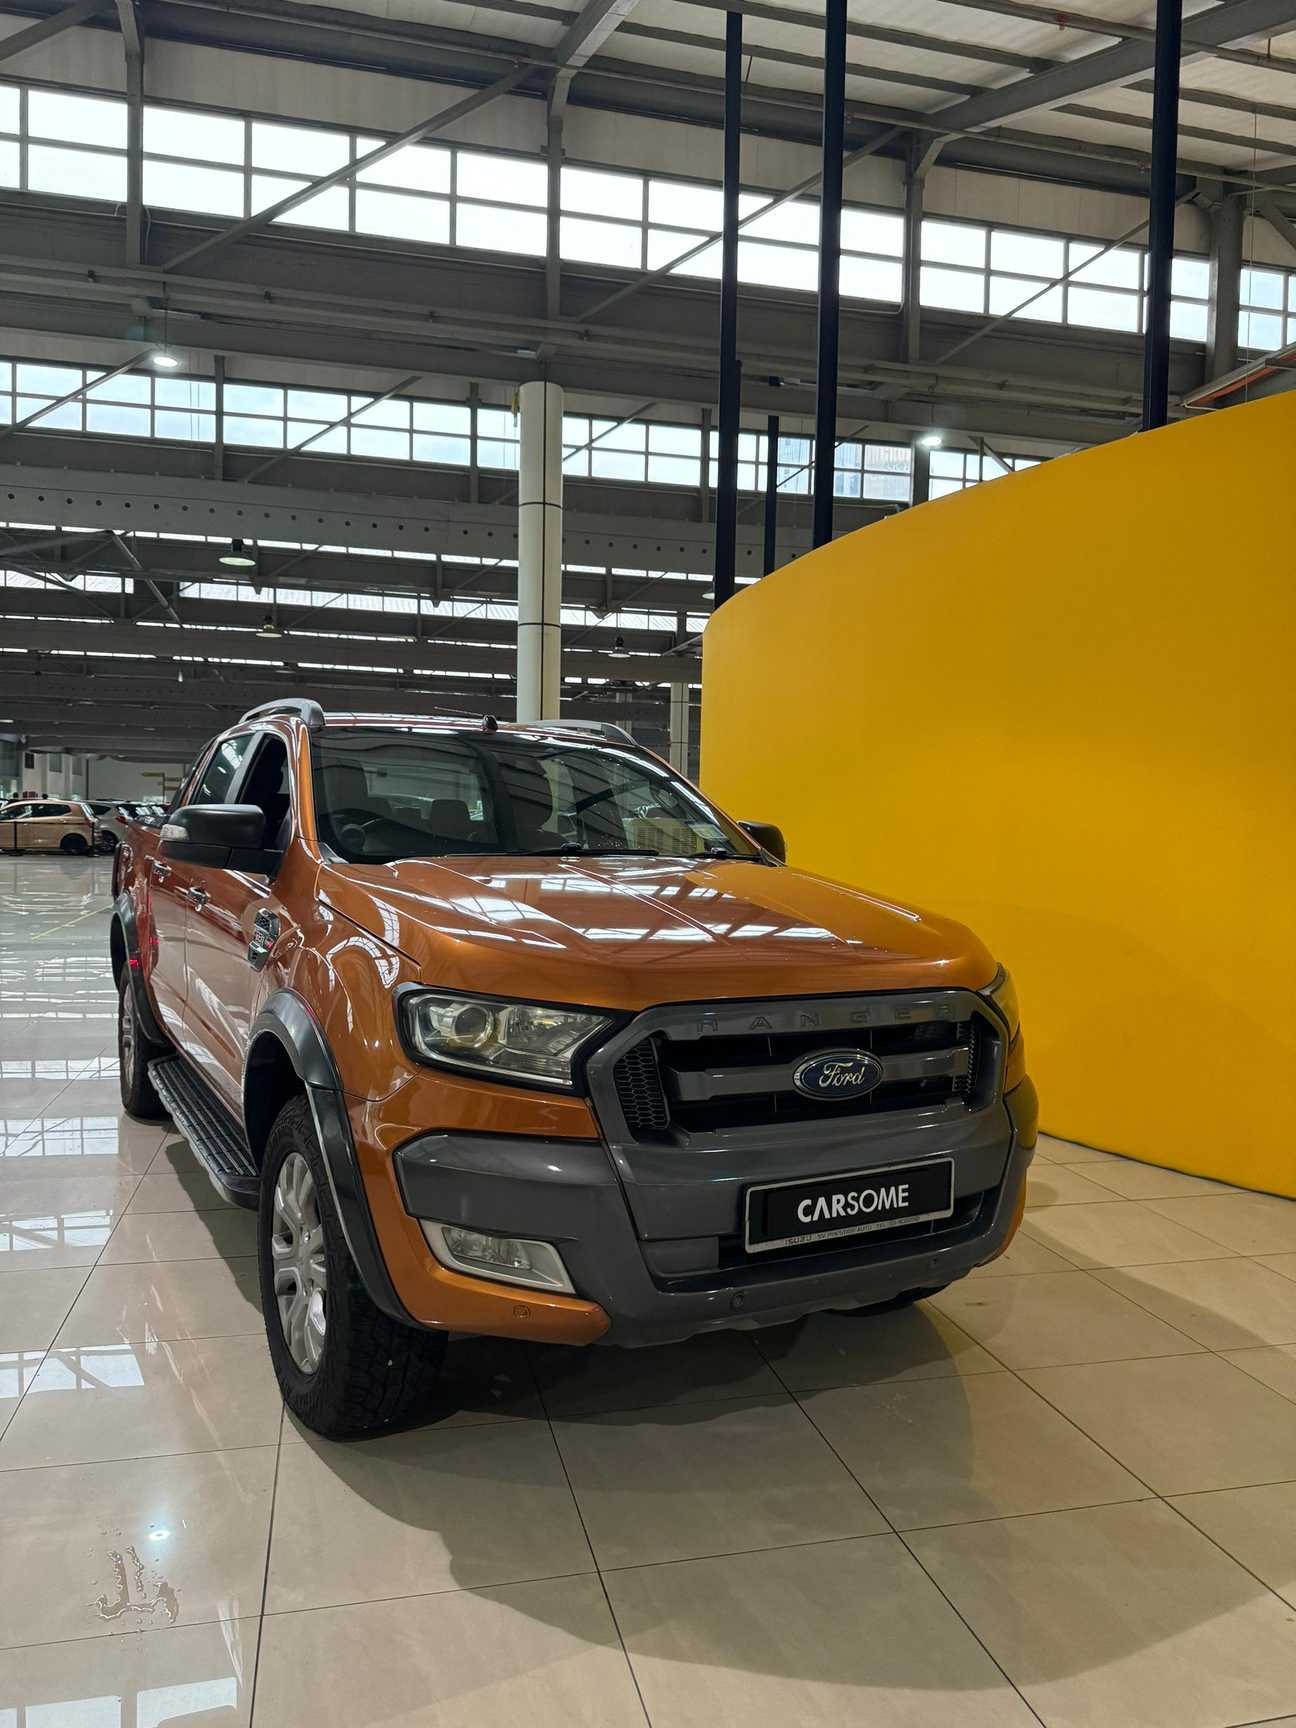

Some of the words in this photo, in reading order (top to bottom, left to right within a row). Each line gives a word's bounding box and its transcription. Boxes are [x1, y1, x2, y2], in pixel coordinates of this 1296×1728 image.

[697, 1003, 957, 1034] RANGER
[818, 1061, 866, 1088] Ford
[797, 1184, 909, 1223] CARSOME
